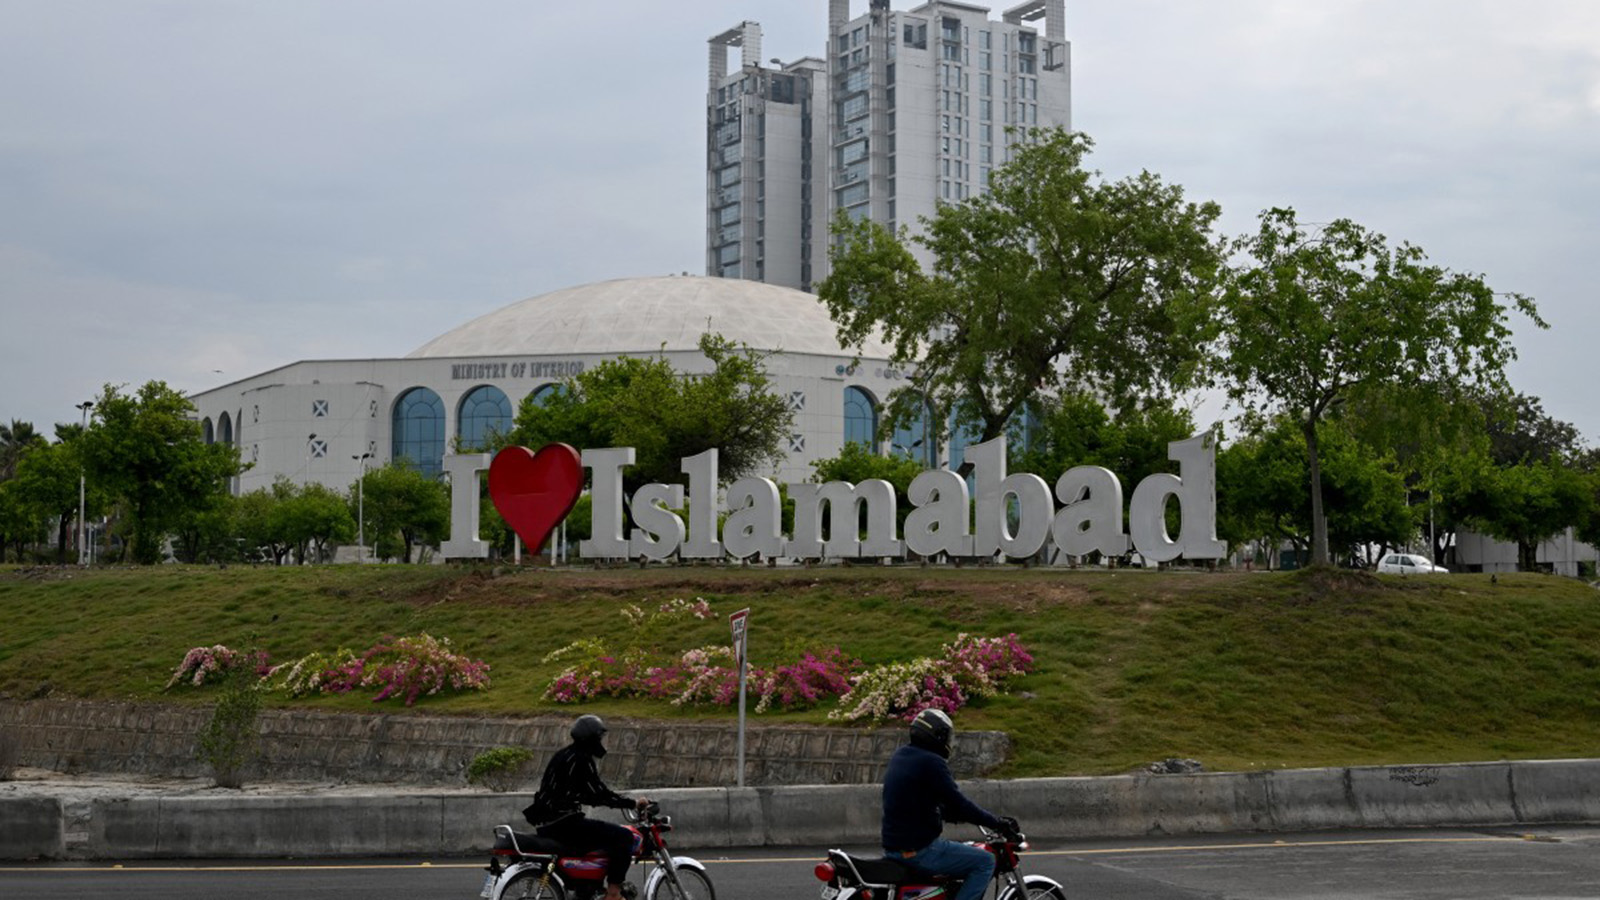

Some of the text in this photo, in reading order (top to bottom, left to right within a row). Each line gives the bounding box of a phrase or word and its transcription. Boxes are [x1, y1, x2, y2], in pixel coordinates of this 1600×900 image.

[451, 361, 585, 380] MINISTRY OF INTERIOR
[440, 430, 1228, 561] I Islamabad
